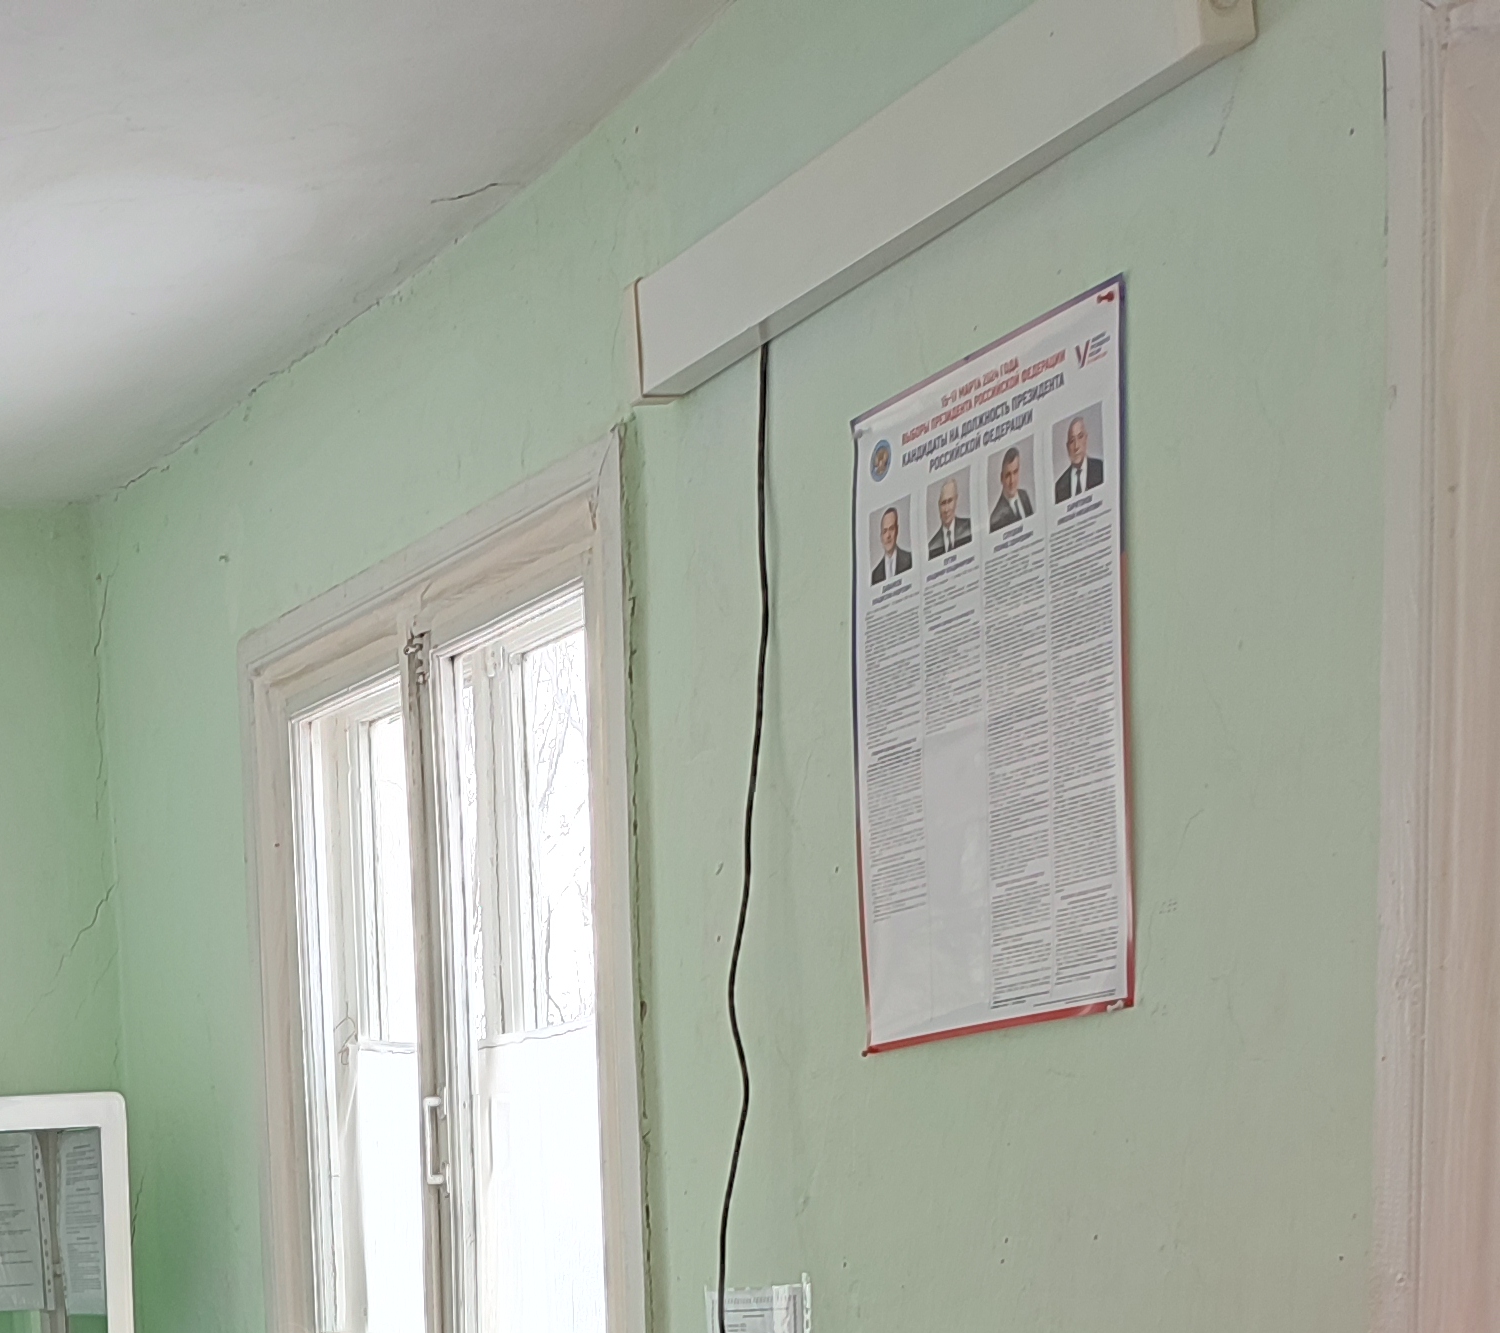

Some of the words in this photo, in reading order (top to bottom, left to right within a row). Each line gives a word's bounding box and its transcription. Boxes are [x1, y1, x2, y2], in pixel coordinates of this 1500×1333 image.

[974, 370, 1020, 408] РОССИЙСКОЙ
[1021, 349, 1066, 383] ФЕДЕРАЦИИ
[902, 431, 948, 468] КАНДИДАТЫ
[949, 426, 960, 444] НА
[960, 400, 1011, 438] ДОЛЖНОСТЬ
[1011, 371, 1065, 412] ПРЕЗИДЕНТА
[928, 432, 981, 474] РОССИЙСКОЙ
[982, 407, 1034, 447] ФЕДЕРАЦИИ
